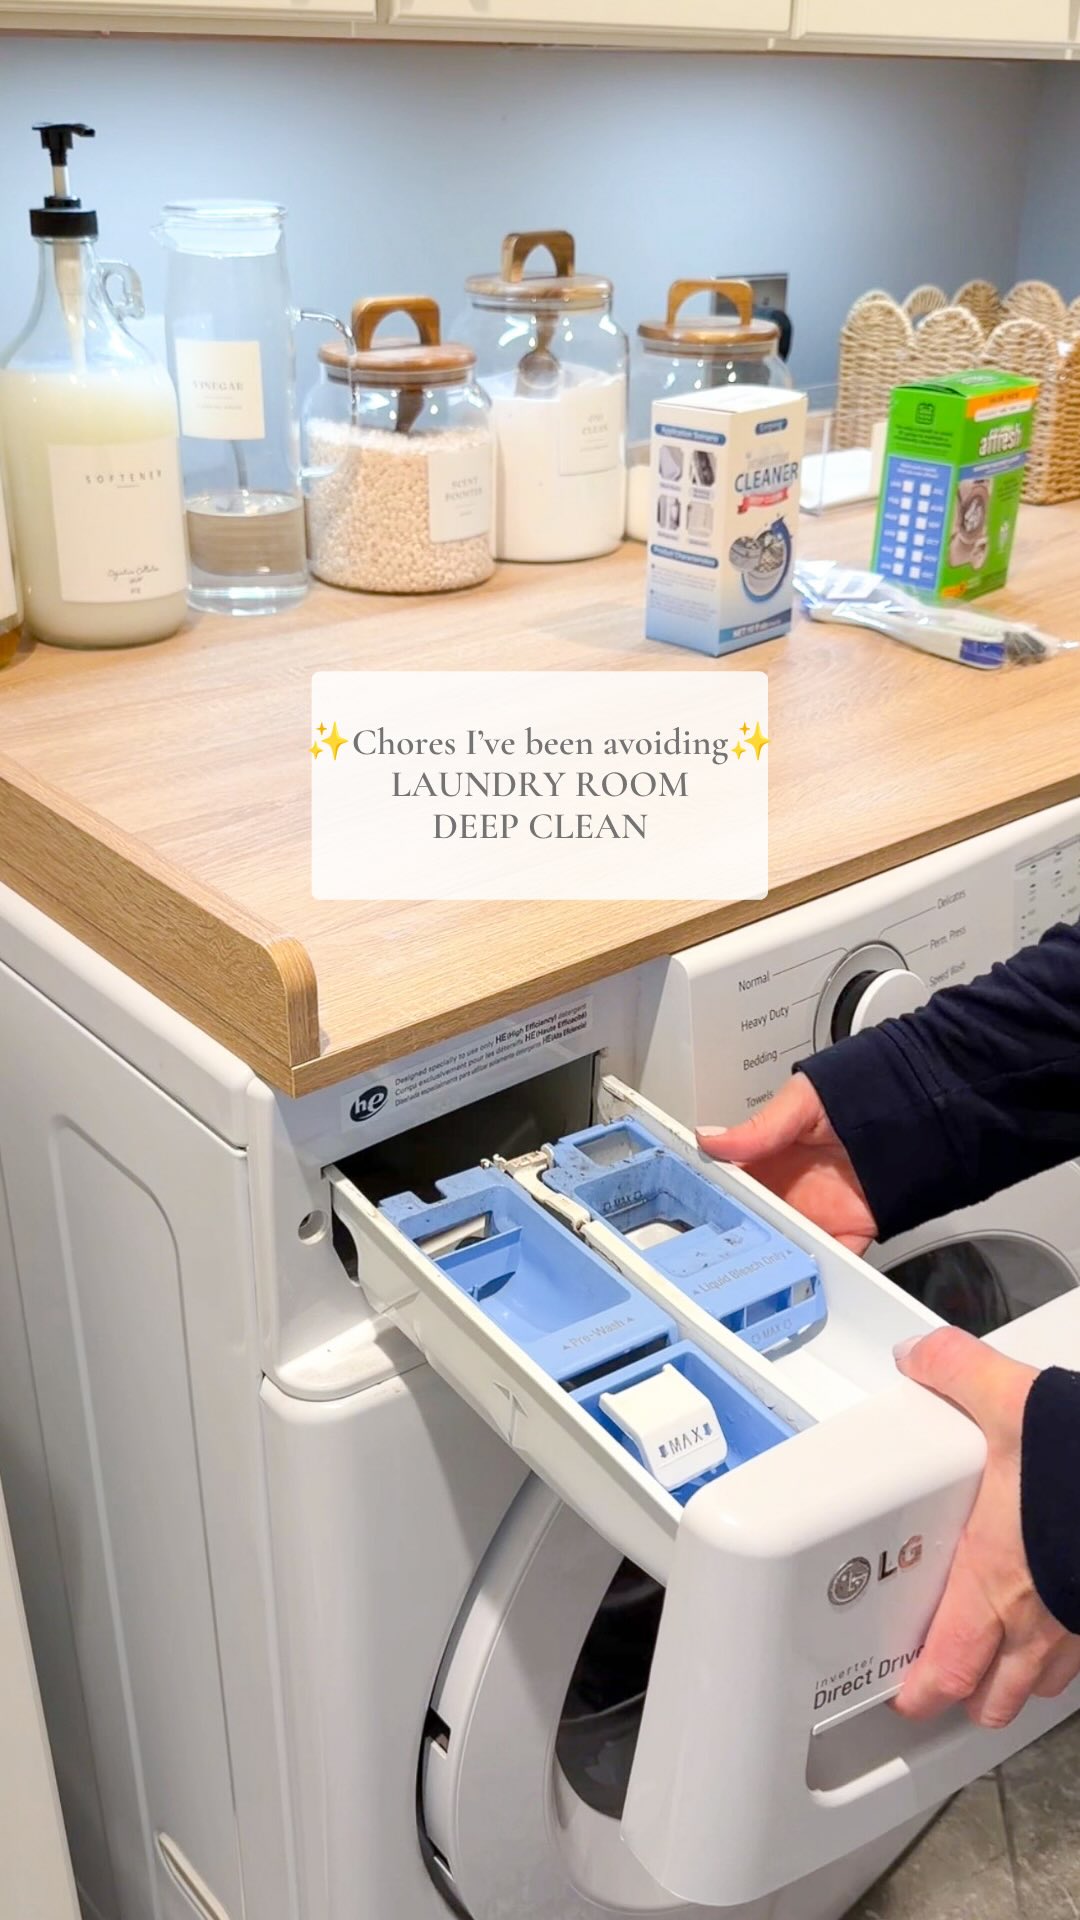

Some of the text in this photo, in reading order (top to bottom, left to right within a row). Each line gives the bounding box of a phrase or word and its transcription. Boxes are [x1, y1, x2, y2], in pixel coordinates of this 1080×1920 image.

[192, 379, 244, 391] VINEGAR
[979, 422, 1022, 456] affresh
[86, 470, 162, 484] SOFTENER
[734, 461, 799, 492] CLEANER
[938, 889, 966, 910] Delicates
[738, 970, 771, 992] Normal
[929, 968, 949, 987] Speed
[741, 1005, 790, 1032] Heavy Duty
[395, 1067, 427, 1086] Designed
[428, 1056, 458, 1073] specially
[466, 1048, 479, 1057] use
[480, 1040, 495, 1051] only
[418, 1062, 467, 1086] exclusivement
[468, 1055, 484, 1067] pour
[743, 1050, 778, 1071] Bedding
[353, 1090, 387, 1117] he
[746, 1089, 774, 1109] Towels
[698, 1250, 787, 1292] Liquid Bleach Only
[568, 1320, 625, 1347] Pre-Wash
[762, 1324, 781, 1338] MAX
[668, 1426, 703, 1455] MAX
[877, 1534, 923, 1581] LG
[815, 1655, 875, 1690] Inverter
[813, 1669, 873, 1710] Direct
